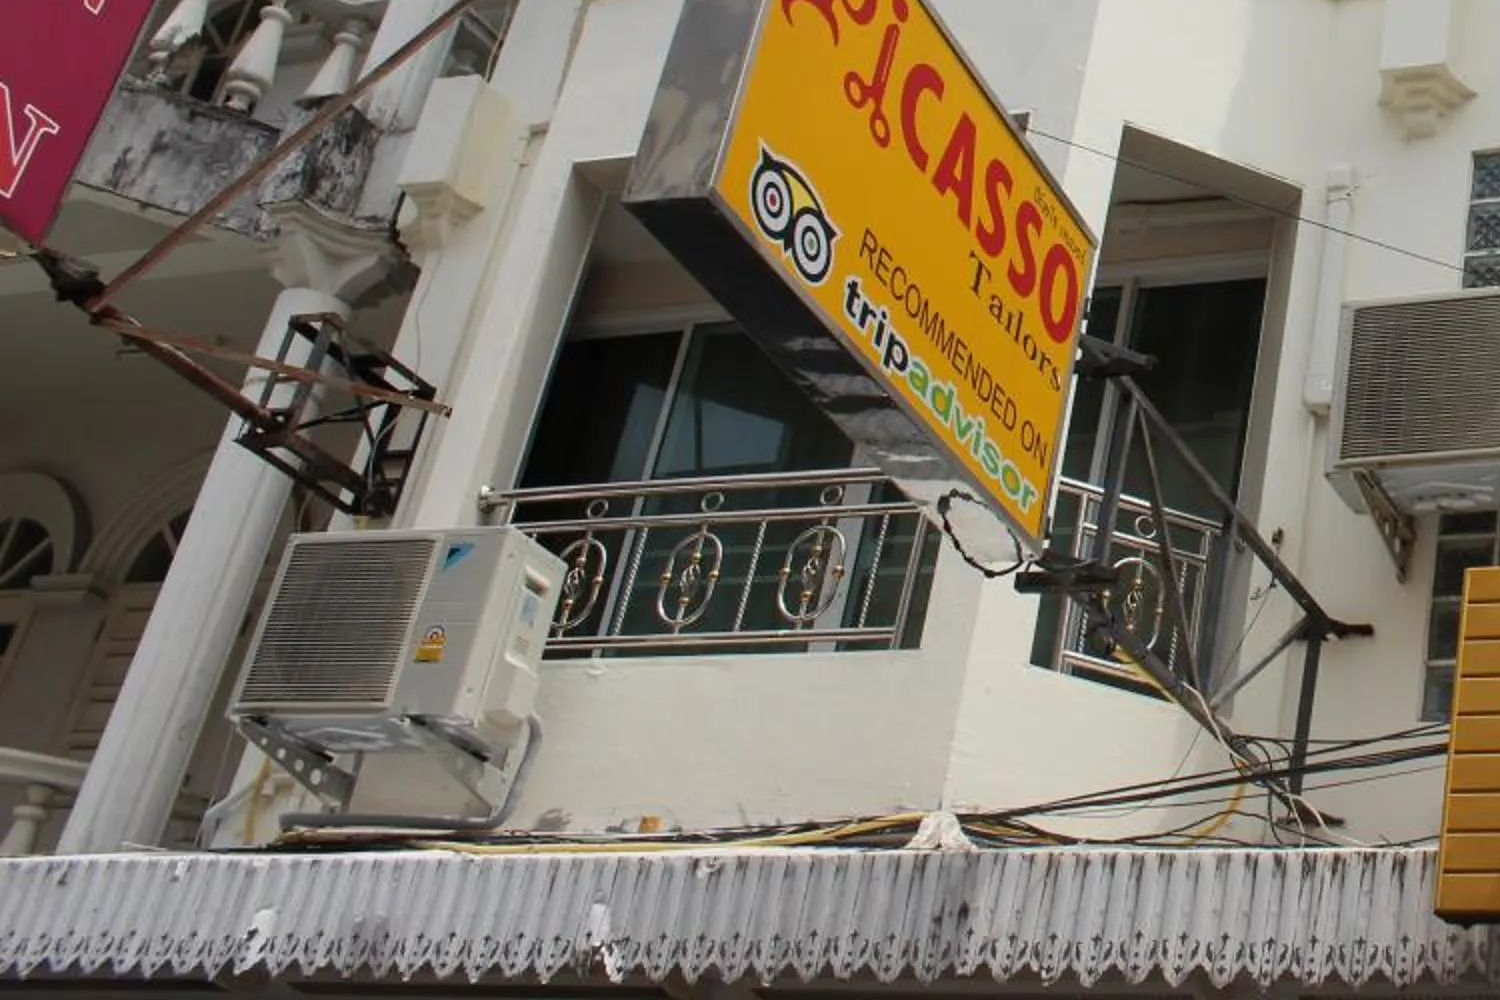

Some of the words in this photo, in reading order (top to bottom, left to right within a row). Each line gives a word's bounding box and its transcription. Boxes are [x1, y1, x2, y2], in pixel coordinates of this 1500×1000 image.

[845, 277, 1038, 512] tripadvisor
[859, 228, 1017, 431] RECOMMENDED
[1020, 420, 1048, 469] ON
[968, 250, 1062, 392] Tailors
